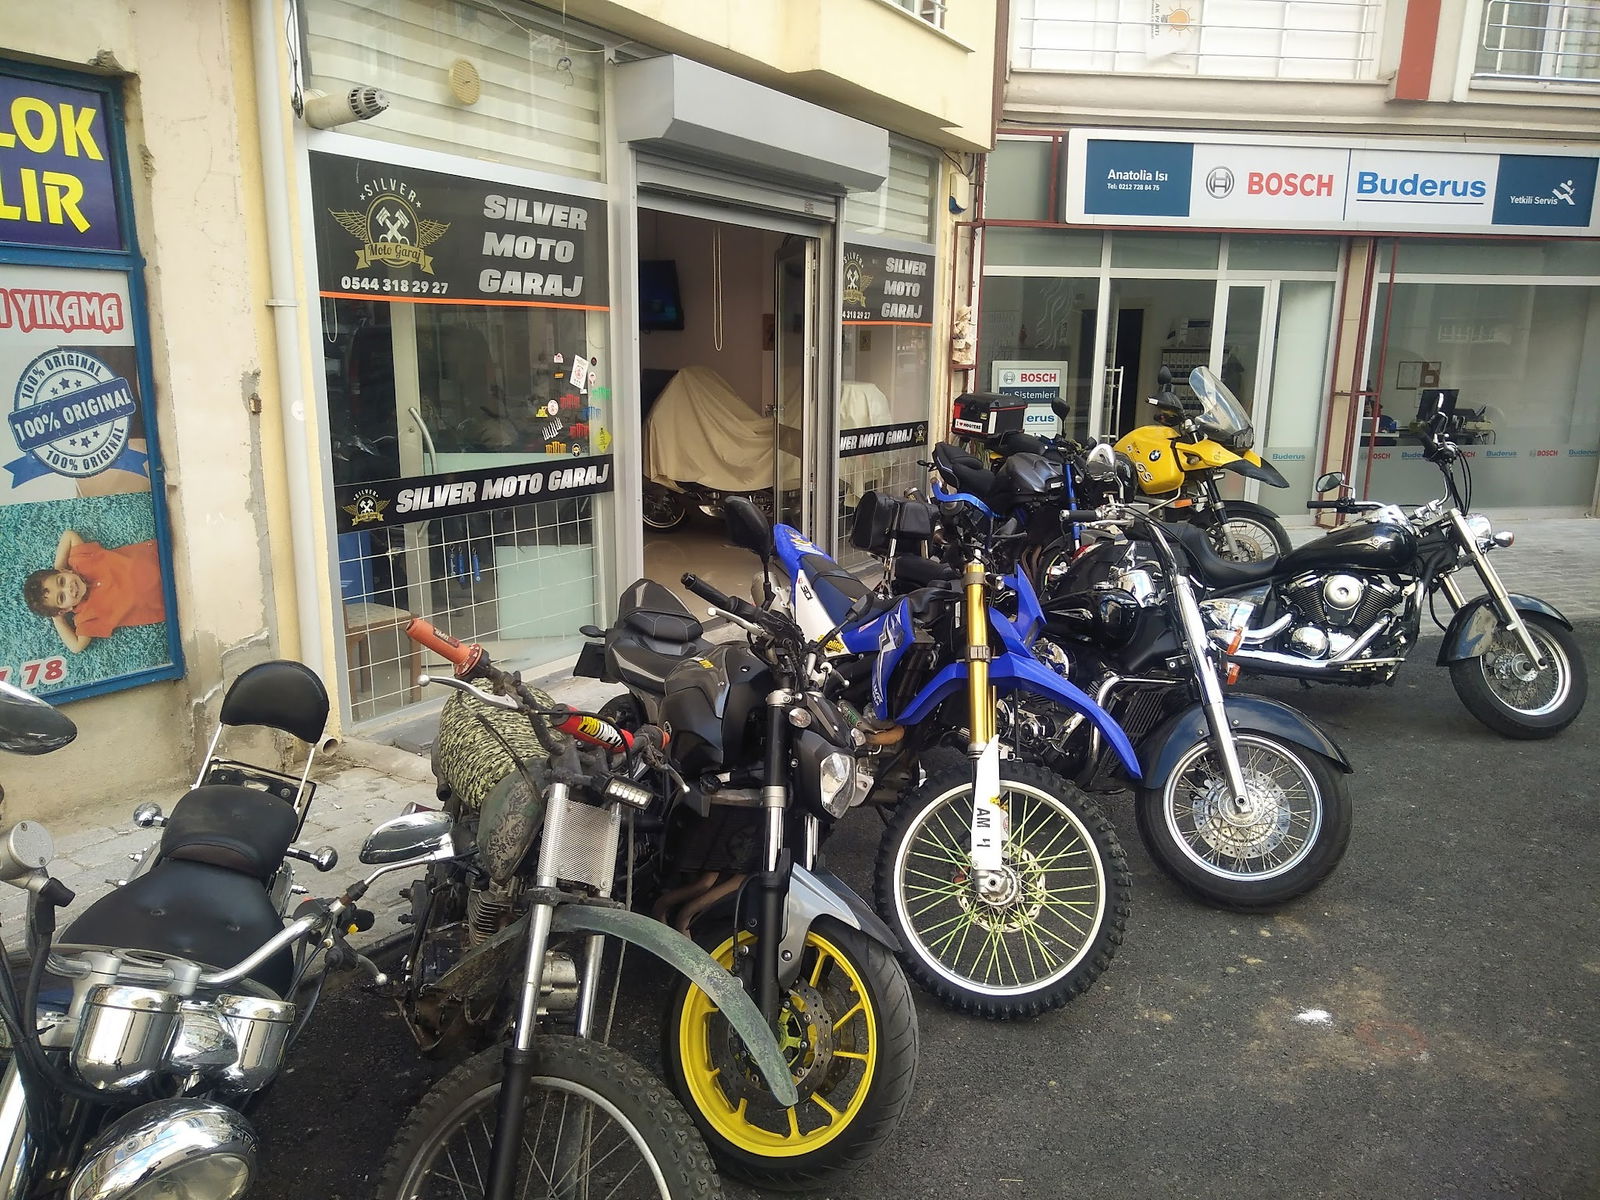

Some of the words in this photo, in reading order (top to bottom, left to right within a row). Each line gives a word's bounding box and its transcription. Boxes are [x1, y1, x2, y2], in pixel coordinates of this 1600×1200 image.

[1107, 168, 1153, 181] Anatolia
[1247, 172, 1334, 197] BOSCH
[1356, 171, 1487, 198] Buderus
[364, 178, 417, 201] SILVER
[1510, 195, 1534, 205] Yetkili
[1534, 196, 1558, 205] Servis
[483, 194, 588, 231] SILVER
[367, 243, 393, 257] Moto
[395, 244, 422, 261] Garaj
[482, 232, 575, 263] MOTO
[885, 257, 927, 276] SILVER
[341, 275, 380, 291] 0544
[382, 278, 410, 292] 318
[412, 281, 430, 293] 29
[432, 282, 449, 295] 27
[478, 269, 584, 298] GARAJ
[883, 279, 921, 298] MOTO
[11, 291, 122, 332] YIKAMA
[881, 302, 923, 319] GARAJ
[21, 366, 45, 399] 100%
[45, 354, 102, 377] ORIGINAL
[1020, 373, 1057, 383] BOSCH
[1014, 390, 1056, 399] Sistemleri
[14, 411, 61, 443] 100%
[62, 387, 132, 425] ORIGINAL
[1026, 414, 1055, 423] erus
[46, 449, 79, 471] 100%
[82, 427, 125, 470] ORIGINAL
[840, 435, 858, 451] VER
[858, 432, 884, 449] MOTO
[885, 428, 913, 445] GARAJ
[1272, 453, 1306, 461] Buderus
[1486, 450, 1517, 458] Buderus
[1536, 449, 1558, 457] BOSCH
[1136, 462, 1153, 483] GS
[396, 481, 478, 513] SILVER
[481, 472, 544, 502] MOTO
[548, 463, 610, 491] GARAJ
[23, 658, 64, 685] 78
